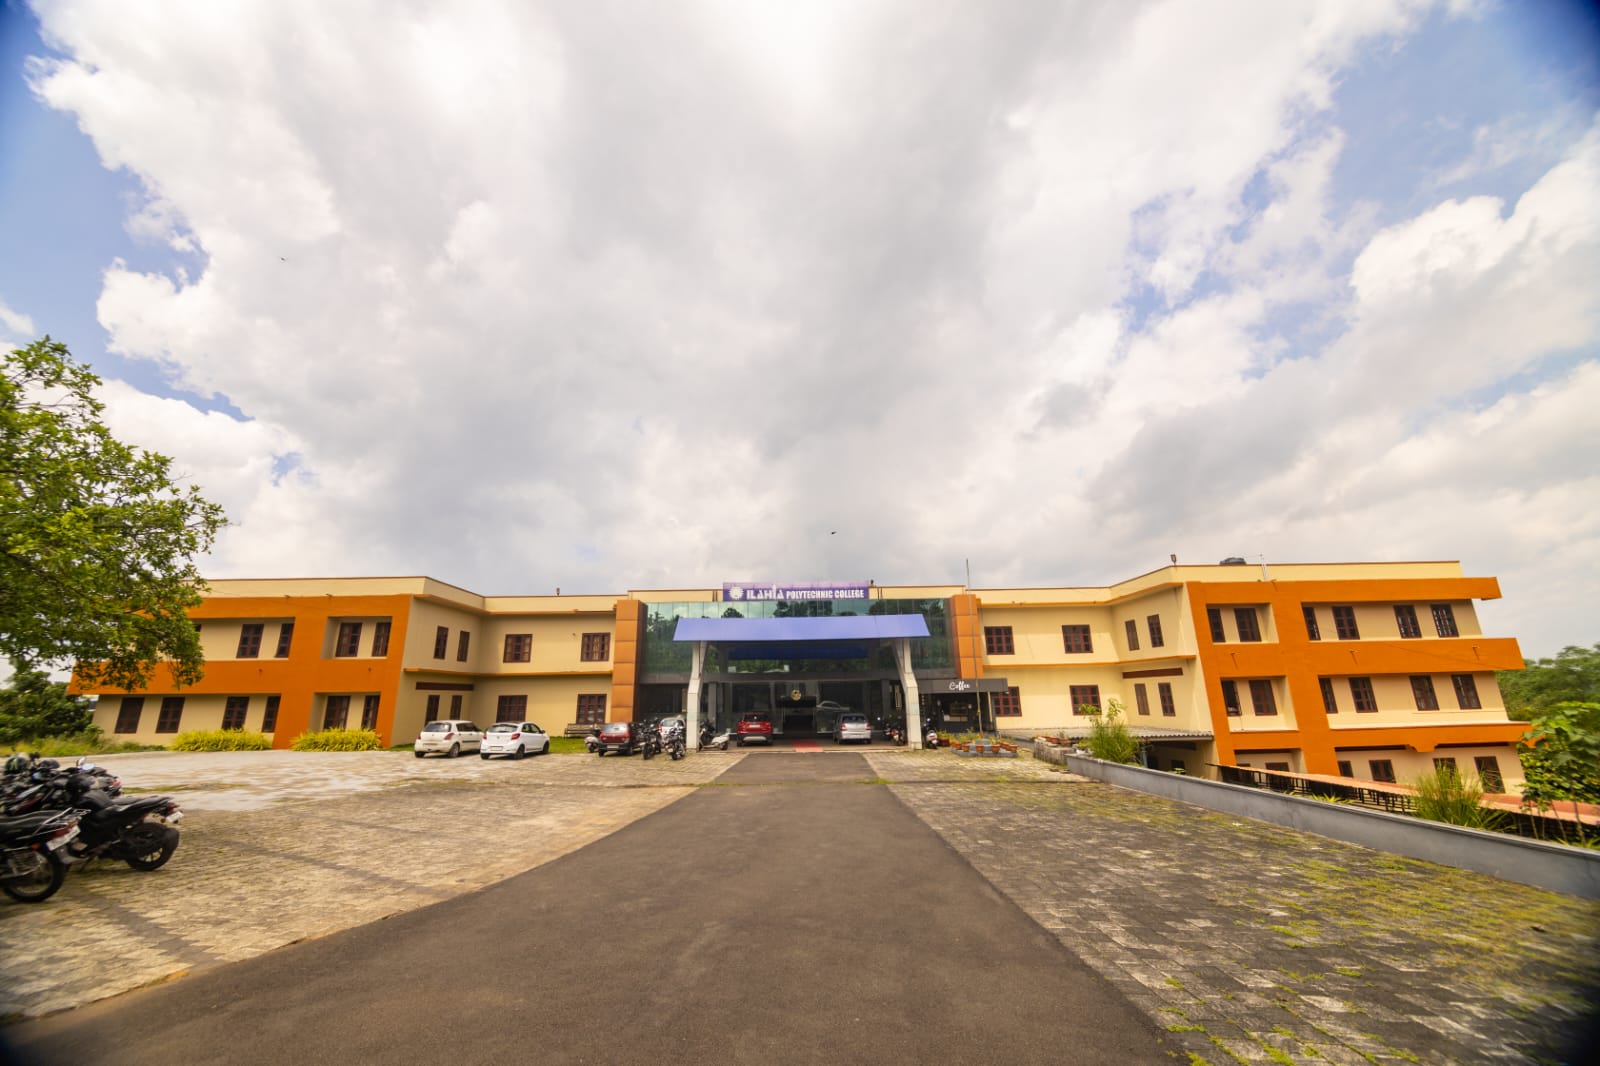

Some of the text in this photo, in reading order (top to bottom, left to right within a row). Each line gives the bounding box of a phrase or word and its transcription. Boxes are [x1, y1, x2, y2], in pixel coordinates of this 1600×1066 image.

[746, 585, 865, 600] ILAHIA POLYTECHNIC COLLEGE
[949, 681, 970, 691] Coffee
